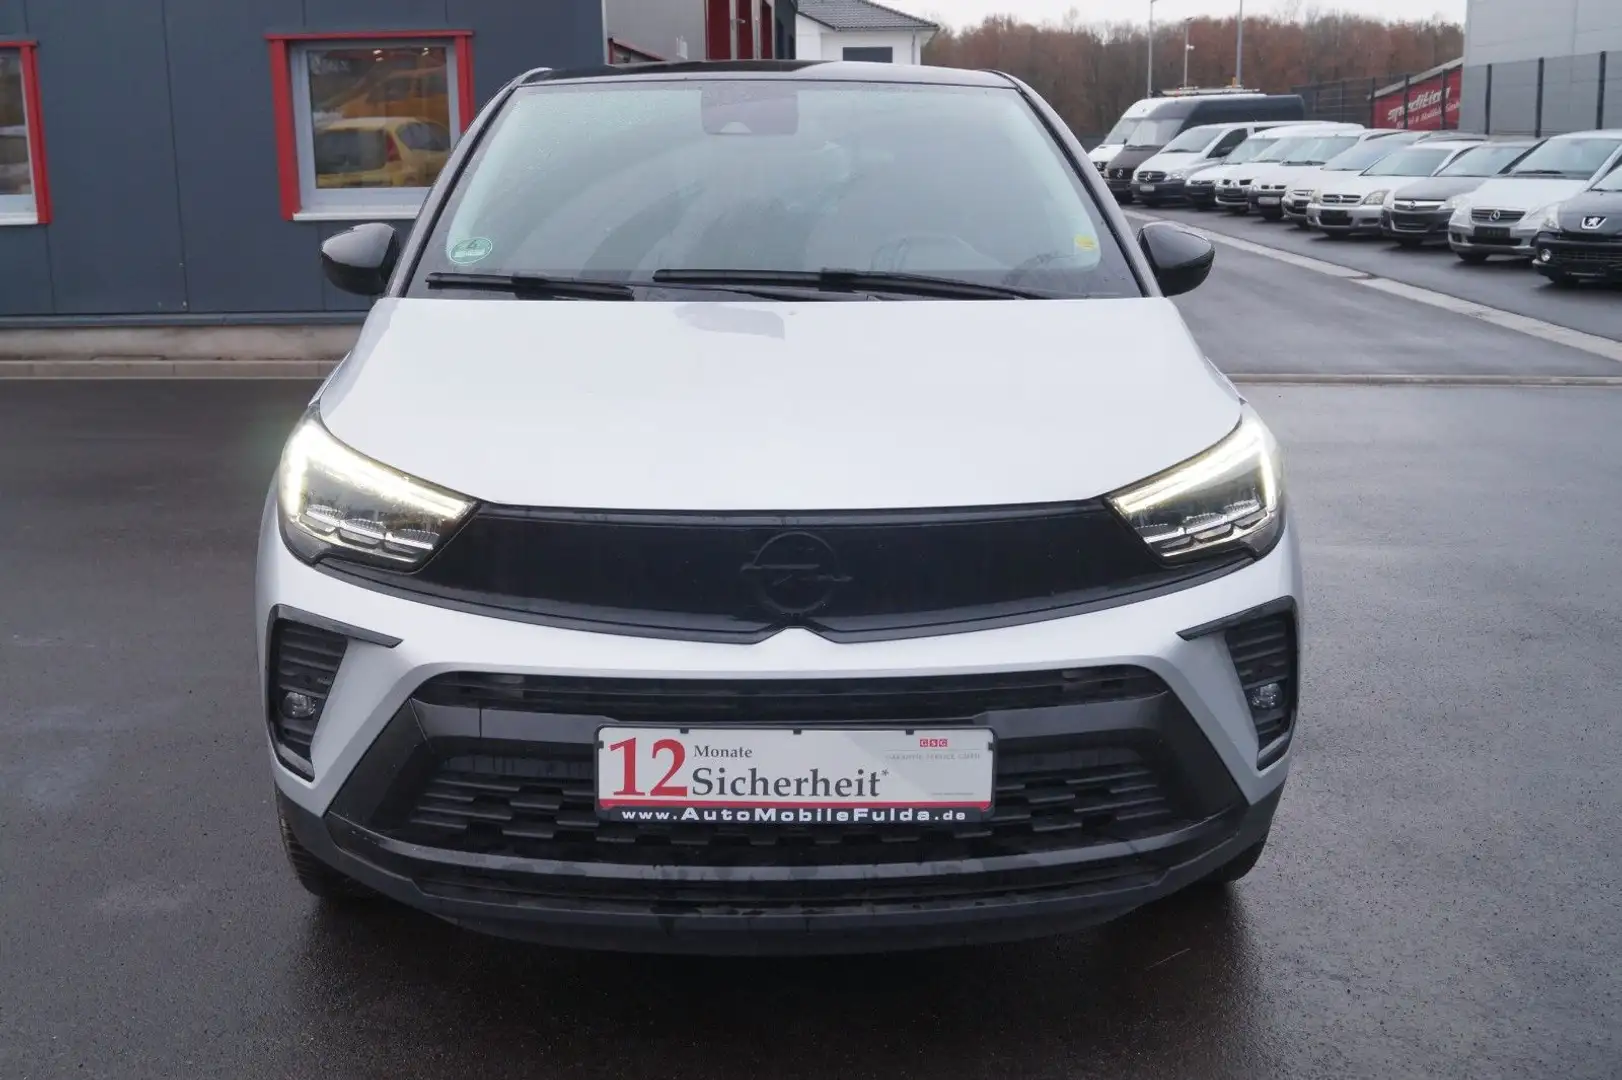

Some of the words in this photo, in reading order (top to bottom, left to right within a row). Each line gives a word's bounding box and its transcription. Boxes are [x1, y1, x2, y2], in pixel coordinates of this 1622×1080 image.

[610, 737, 688, 797] 12
[694, 745, 753, 758] Monate
[621, 808, 966, 821] www.AutoMobileFulda.de
